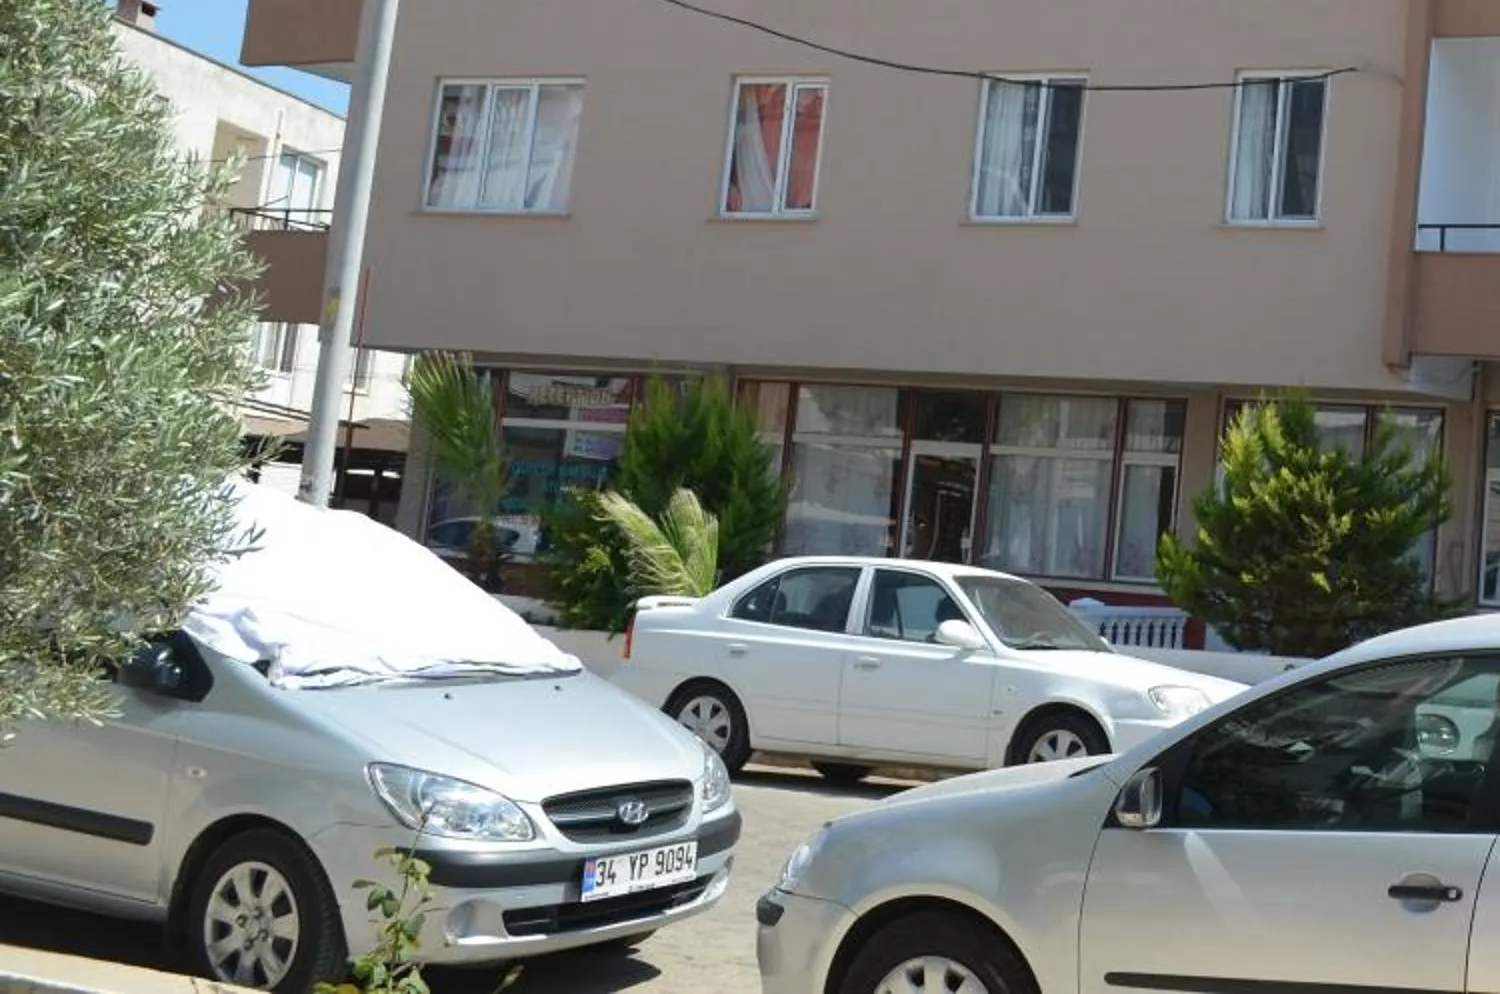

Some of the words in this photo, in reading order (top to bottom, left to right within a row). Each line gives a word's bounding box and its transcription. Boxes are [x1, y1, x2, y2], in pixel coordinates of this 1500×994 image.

[595, 860, 617, 887] 34
[629, 853, 649, 881] YP
[655, 844, 693, 875] 9094
